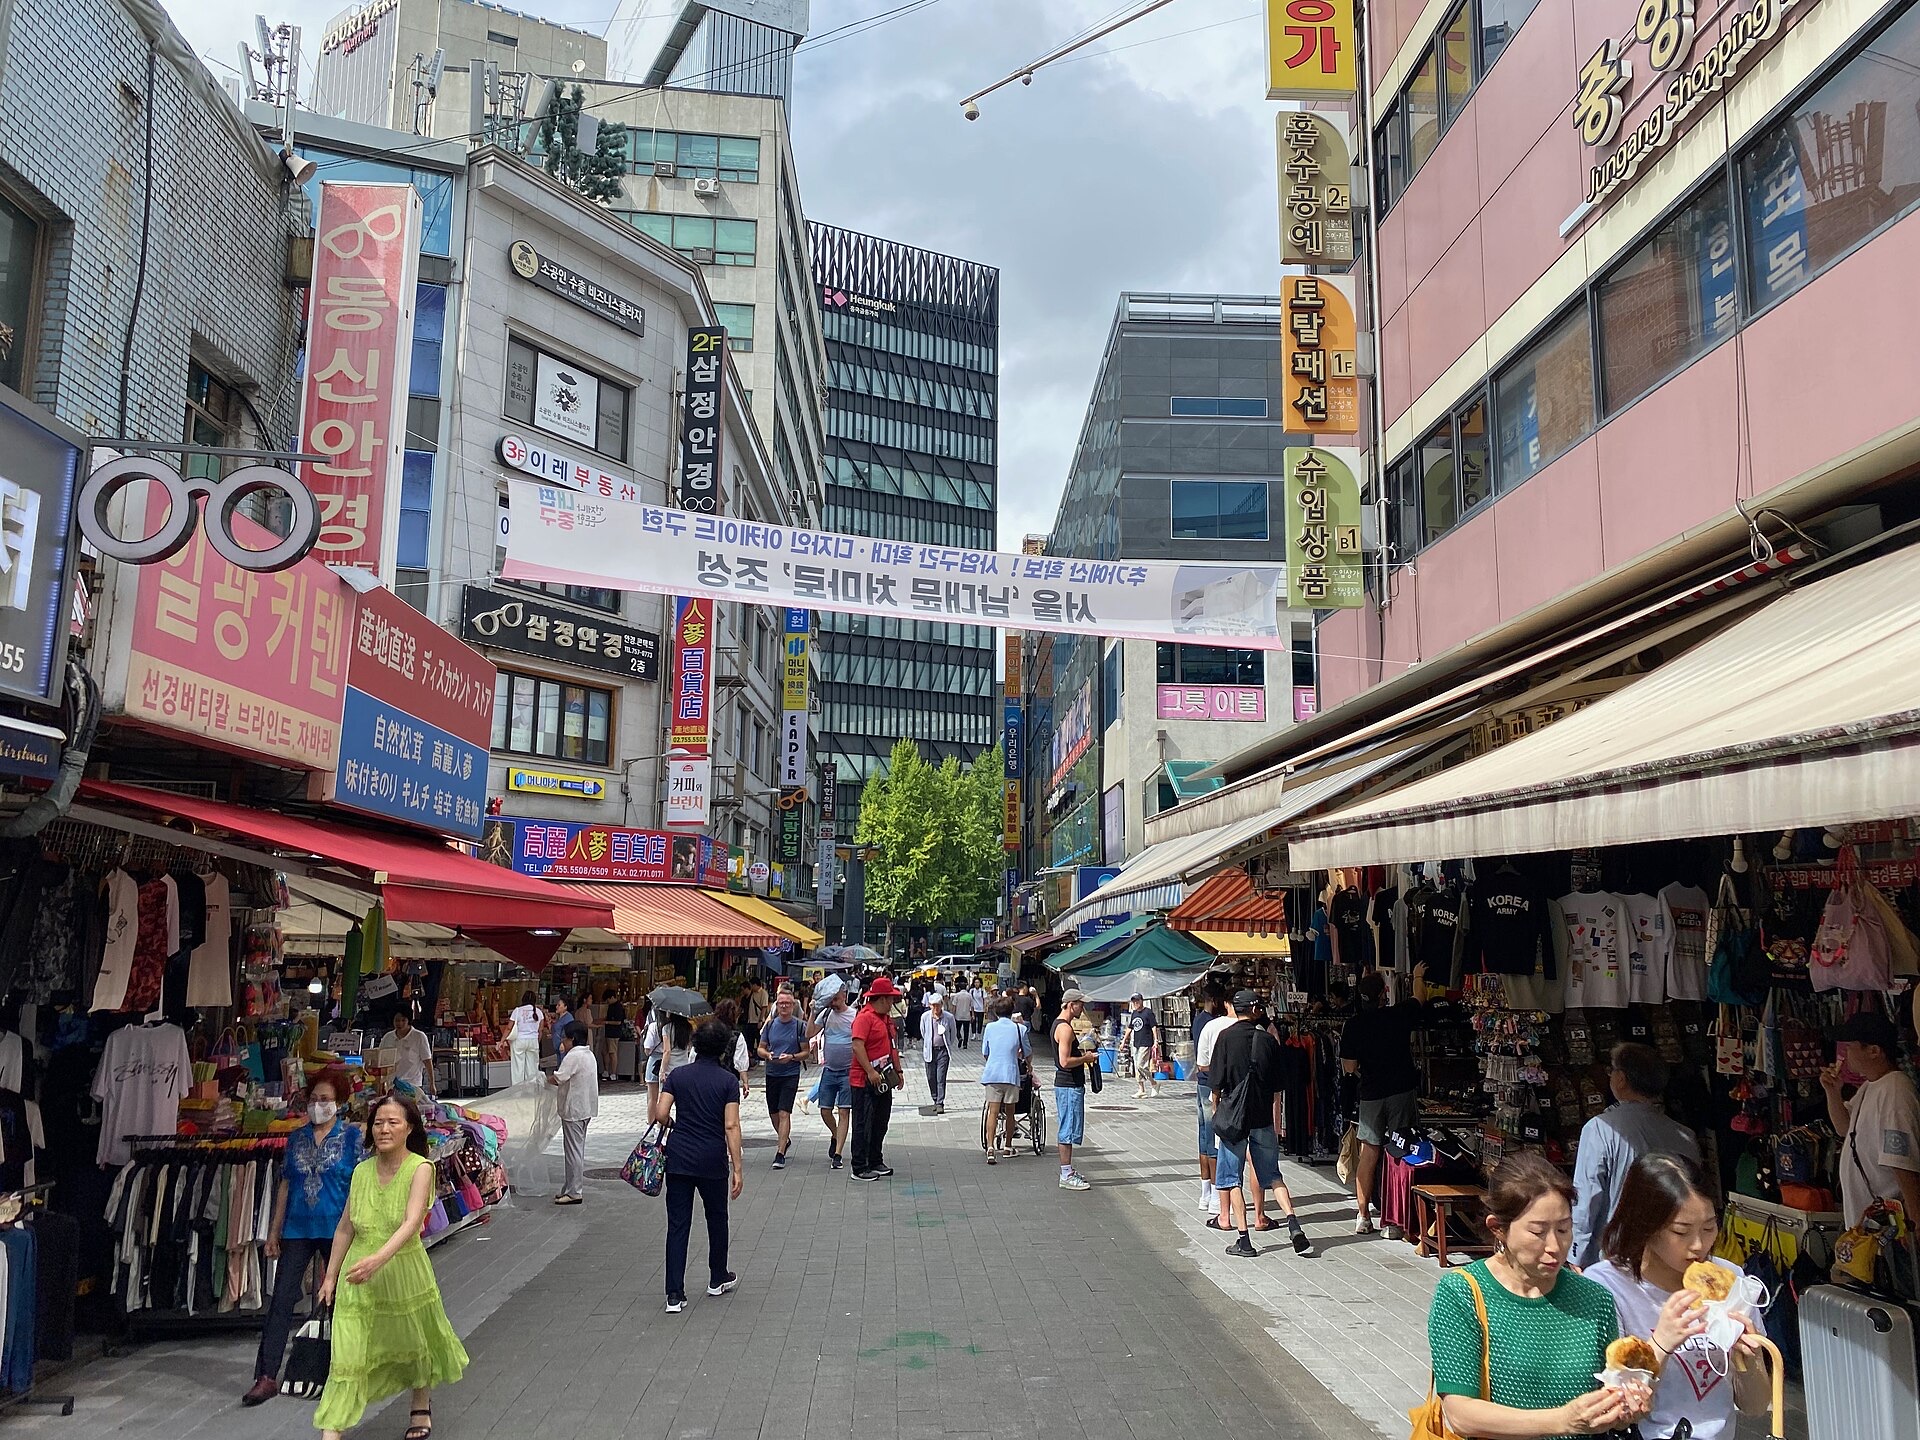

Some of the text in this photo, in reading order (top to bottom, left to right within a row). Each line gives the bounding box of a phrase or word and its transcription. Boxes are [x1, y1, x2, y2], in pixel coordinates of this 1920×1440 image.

[1586, 0, 1773, 204] Jungang Shopping
[1284, 112, 1323, 256] 혼수공예
[1328, 187, 1348, 207] 2F
[541, 261, 642, 324] 소공인 수출 비즈니스플라자
[850, 294, 897, 312] Heungkuk
[692, 333, 722, 352] 2F
[1289, 280, 1328, 422] 토탈패션
[1334, 353, 1353, 373] 1F
[310, 276, 391, 552] 동신안경
[685, 355, 719, 490] 삼정안경
[505, 440, 525, 462] 3F
[1294, 450, 1332, 599] 수입상품
[1340, 528, 1357, 549] B1
[357, 607, 493, 719] 産地直送 ディスカウント ストア
[630, 657, 646, 674] 2층
[788, 659, 805, 668] 머니
[1163, 689, 1259, 714] 그릇 이불
[373, 714, 425, 766] 自然松茸
[344, 758, 398, 804] 味付きのり
[402, 776, 430, 813] キムチ
[433, 789, 453, 819] 塩辛
[527, 774, 559, 789] 머니마켓
[670, 795, 704, 810] 브런치
[782, 811, 800, 858] 보람안경
[1487, 895, 1530, 911] KOREA
[1496, 907, 1518, 916] ARMY
[1432, 908, 1459, 925] KOREA
